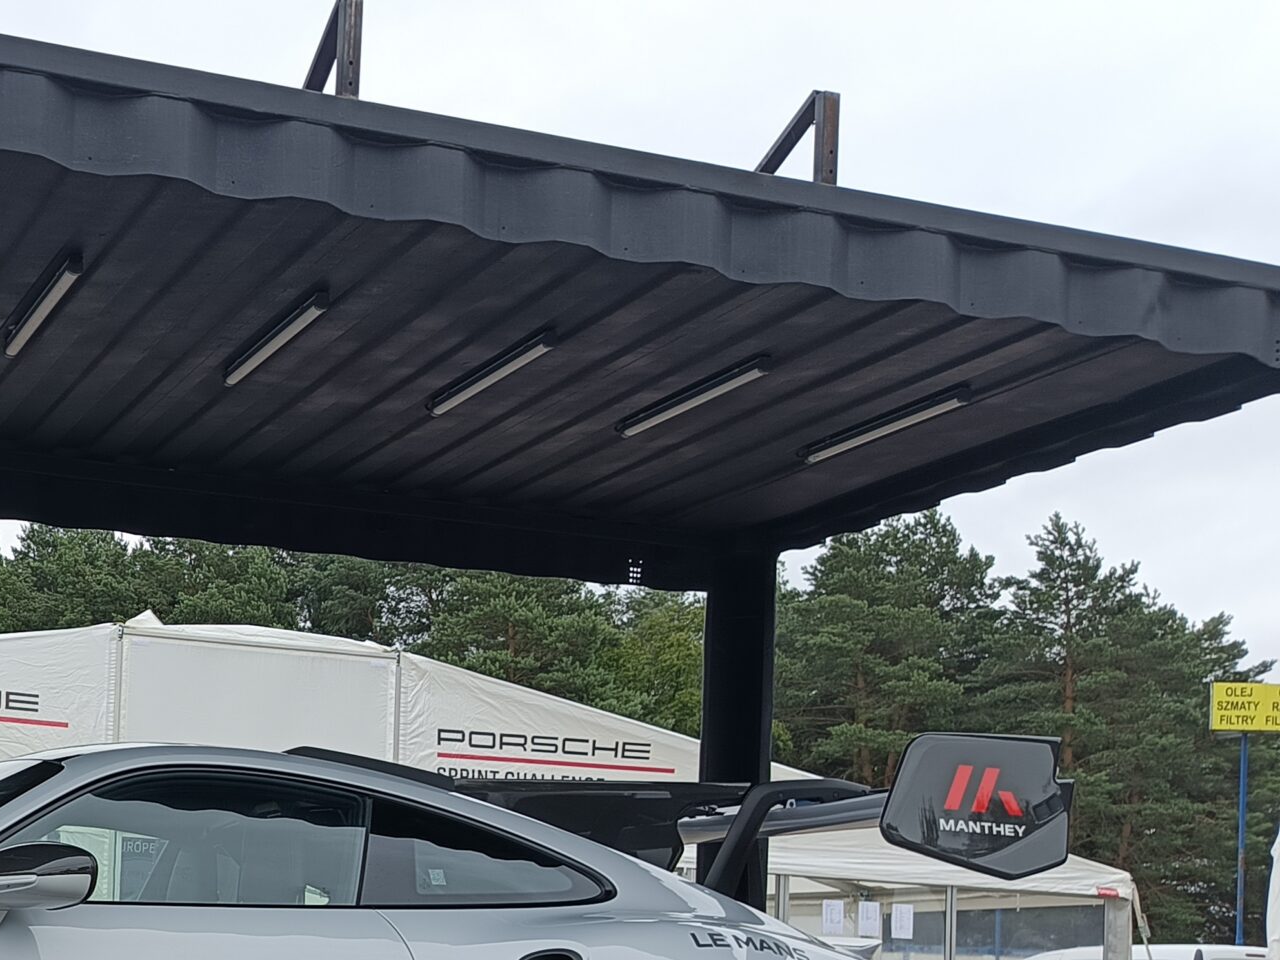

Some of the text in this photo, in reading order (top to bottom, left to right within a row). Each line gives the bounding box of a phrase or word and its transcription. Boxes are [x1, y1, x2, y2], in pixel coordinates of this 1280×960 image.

[1225, 686, 1253, 697] OLEJ
[1216, 700, 1260, 711] SZMATY
[1219, 714, 1256, 725] FILTRY
[1265, 715, 1280, 726] FIL
[437, 728, 652, 760] PORSCHE
[939, 818, 1026, 837] MANTHEY
[690, 932, 732, 948] LE
